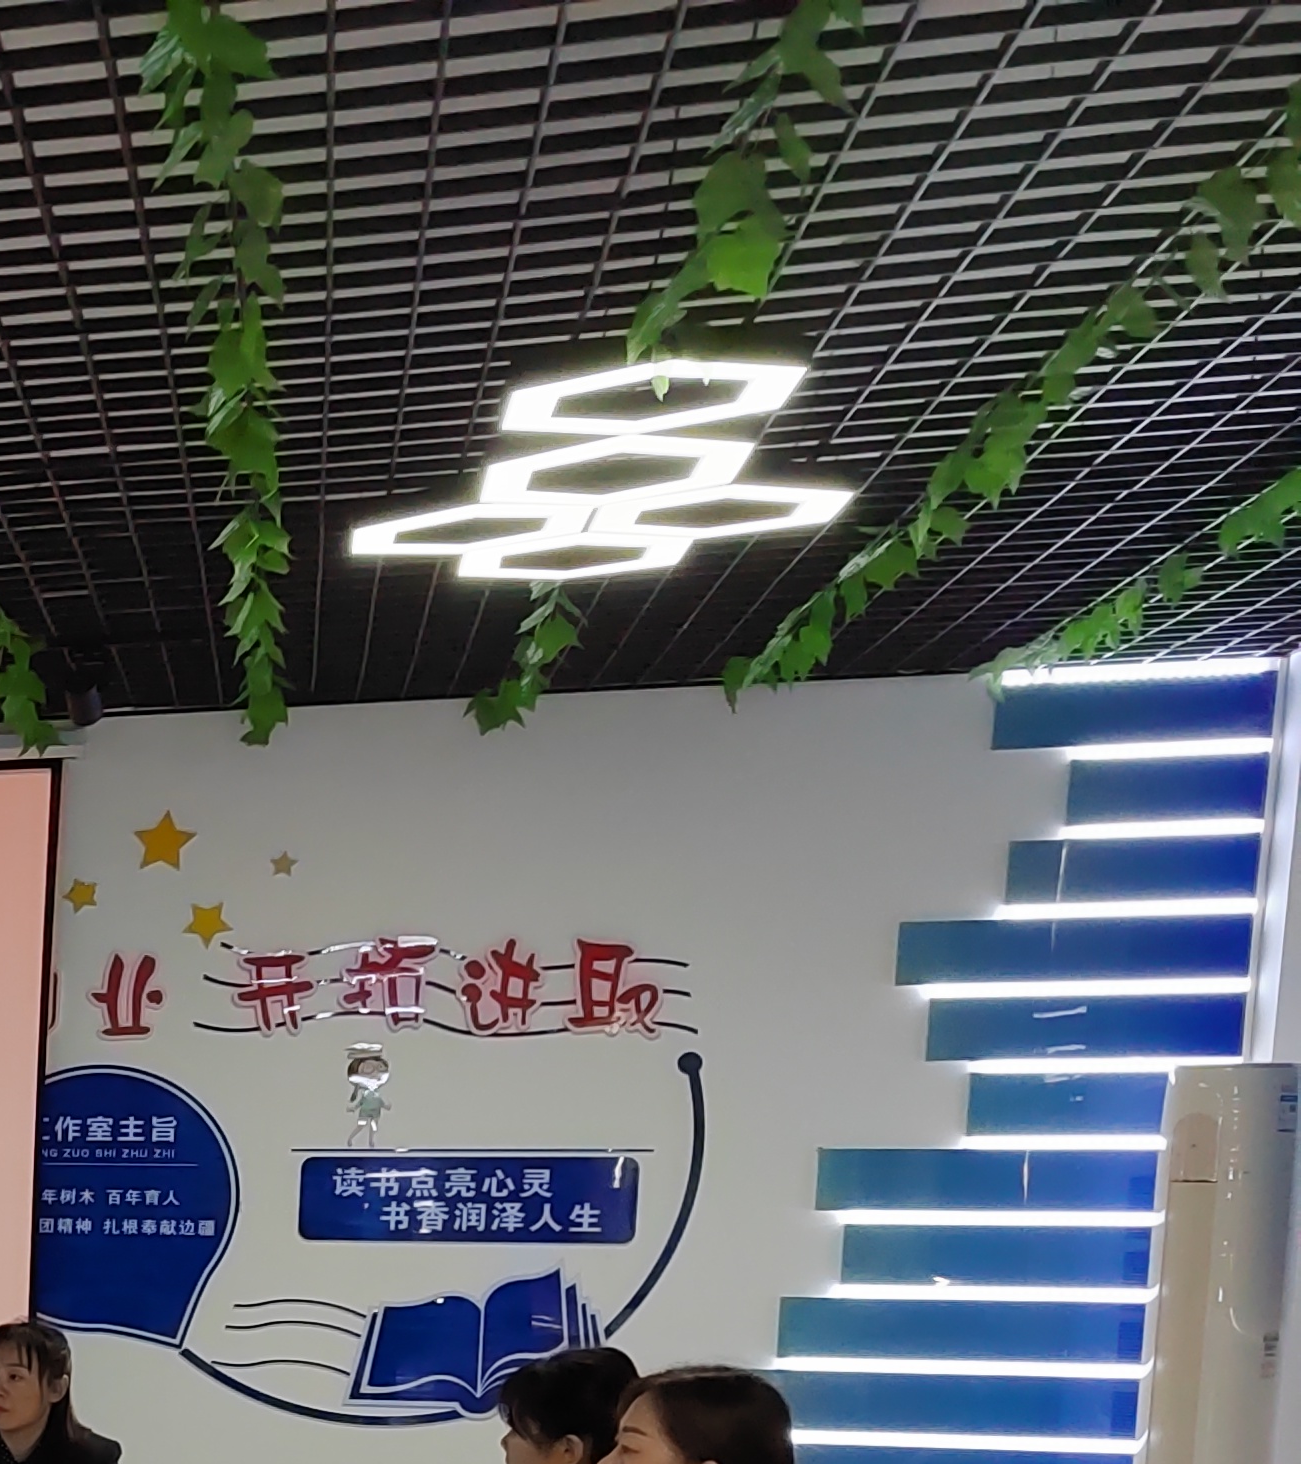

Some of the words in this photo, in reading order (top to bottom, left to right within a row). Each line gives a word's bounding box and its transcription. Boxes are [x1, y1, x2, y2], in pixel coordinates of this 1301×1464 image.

[42, 1116, 178, 1142] 作室主旨
[63, 1149, 90, 1158] ZUO
[96, 1149, 116, 1158] SHI
[121, 1149, 148, 1158] ZHU
[153, 1149, 175, 1159] ZHI
[332, 1168, 553, 1198] 读书点亮心灵
[106, 1189, 180, 1206] 百年育人
[103, 1218, 216, 1236] 扎根奉献边疆
[379, 1202, 602, 1233] 书香润泽人生
